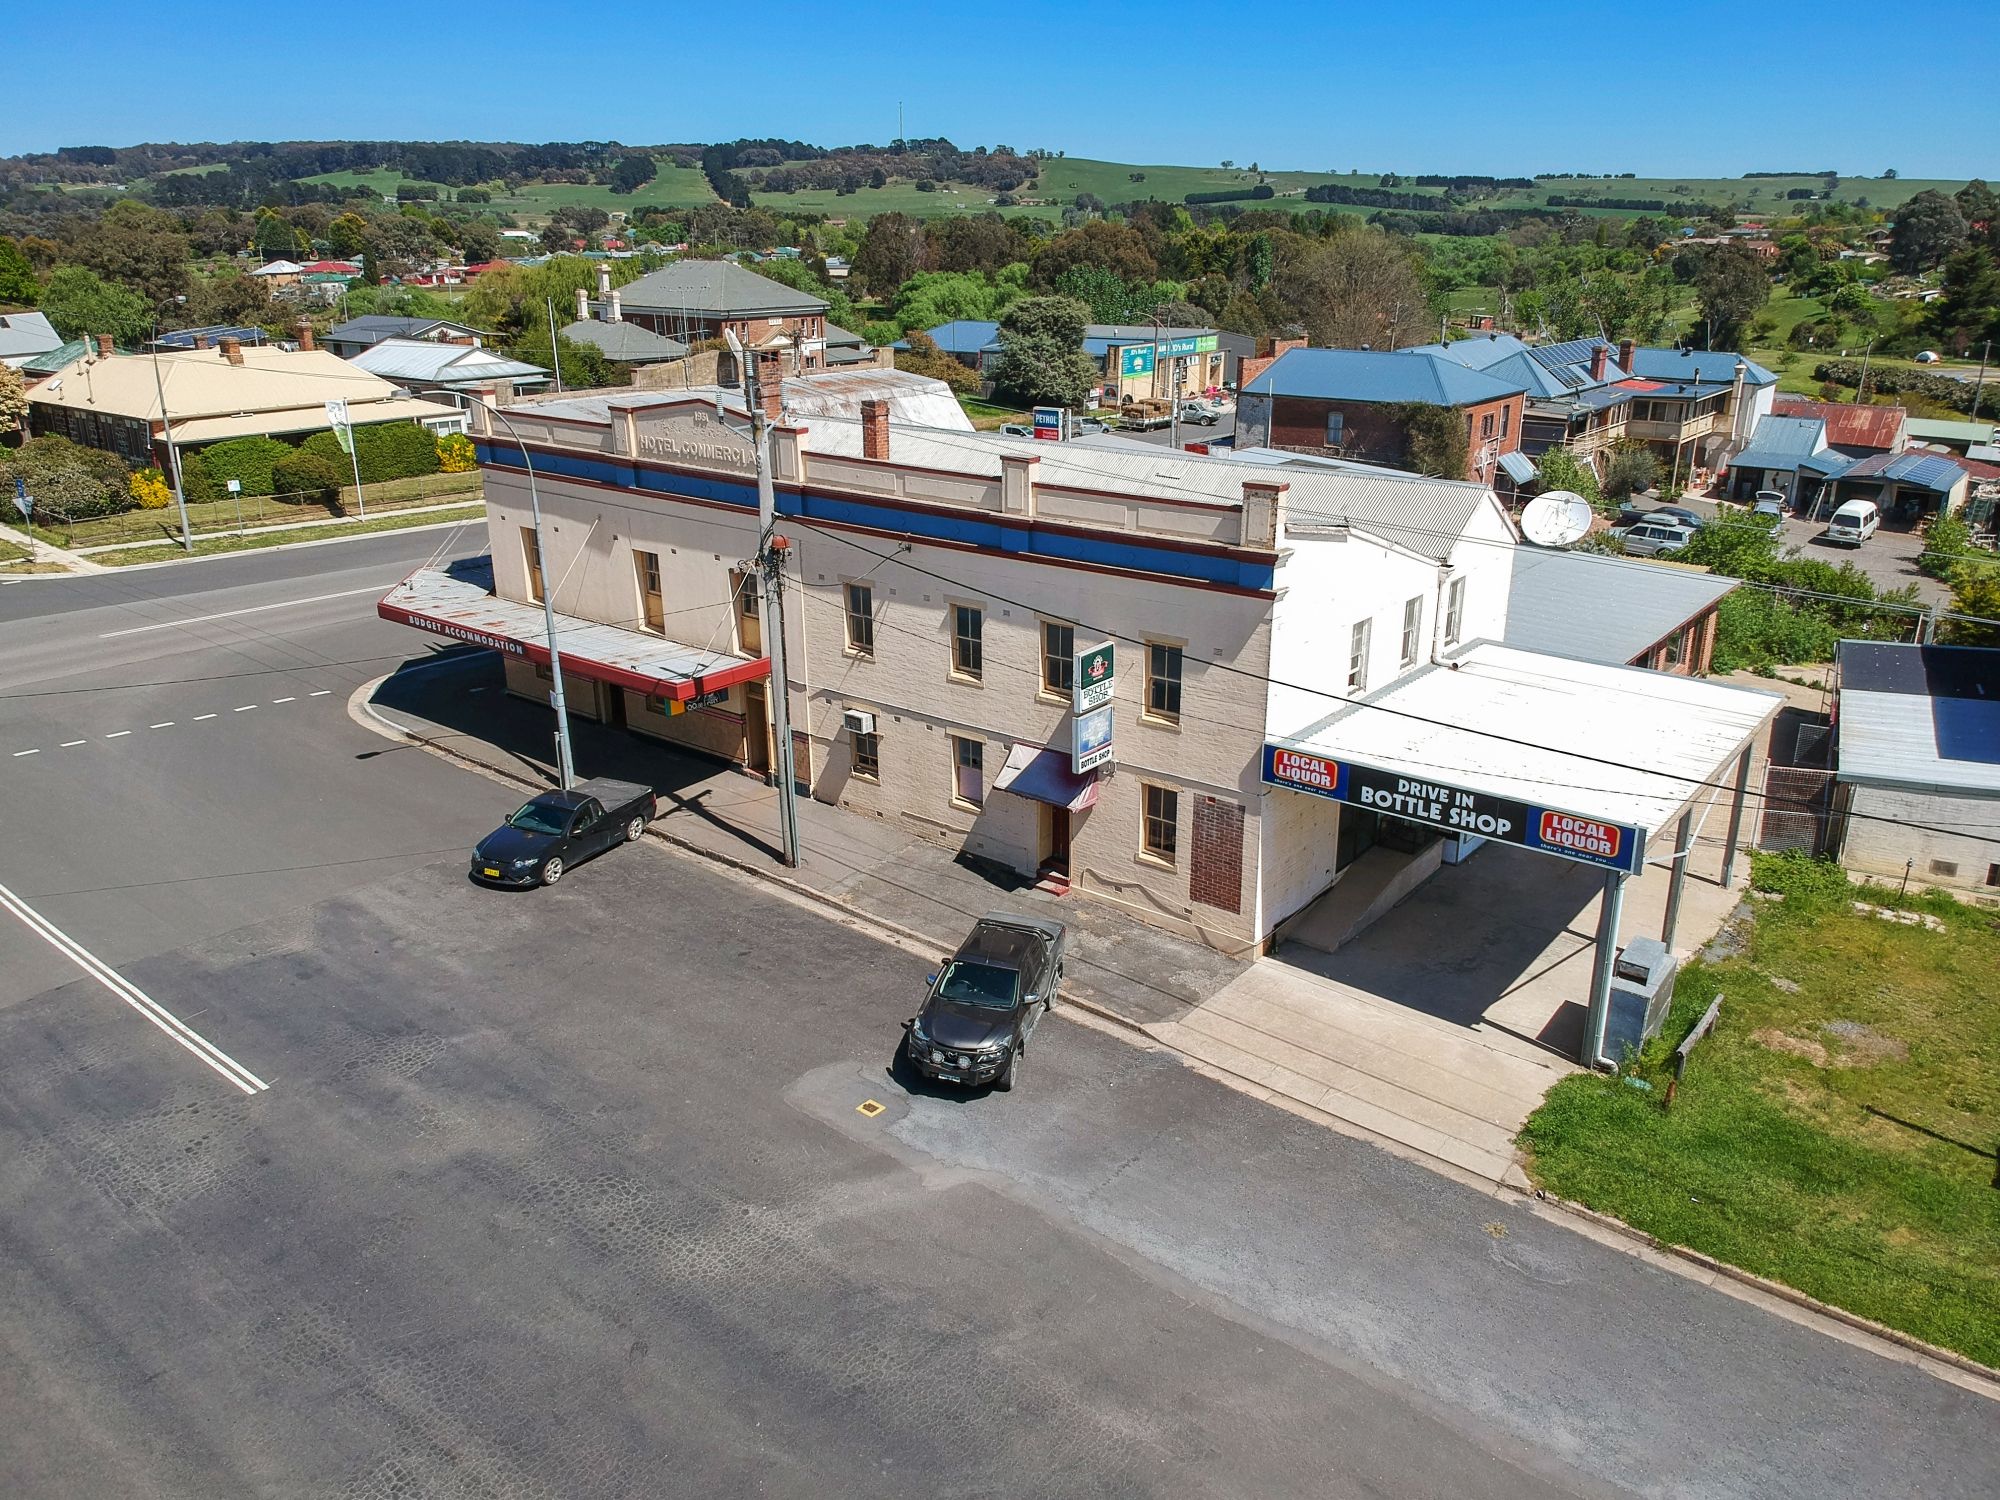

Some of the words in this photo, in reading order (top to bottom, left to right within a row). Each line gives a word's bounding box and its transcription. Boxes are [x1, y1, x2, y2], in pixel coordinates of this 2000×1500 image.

[1035, 414, 1058, 425] PETROL
[640, 434, 680, 457] HOTEL
[681, 441, 757, 466] COMMERCIA
[408, 615, 442, 632] BUDGET
[444, 625, 523, 655] ACCOMMODATION
[1083, 680, 1113, 699] BOTTLE
[1088, 690, 1109, 705] SHOP
[1080, 754, 1098, 769] BOTTLE
[1098, 749, 1110, 761] SHOP
[1283, 753, 1328, 774] LOCAL
[1398, 778, 1449, 803] DRIVE
[1455, 792, 1475, 809] IN
[1360, 786, 1442, 821] BOTTLE
[1449, 807, 1512, 835] SHOP
[1552, 815, 1608, 840] LOCAL
[1540, 843, 1562, 852] there's
